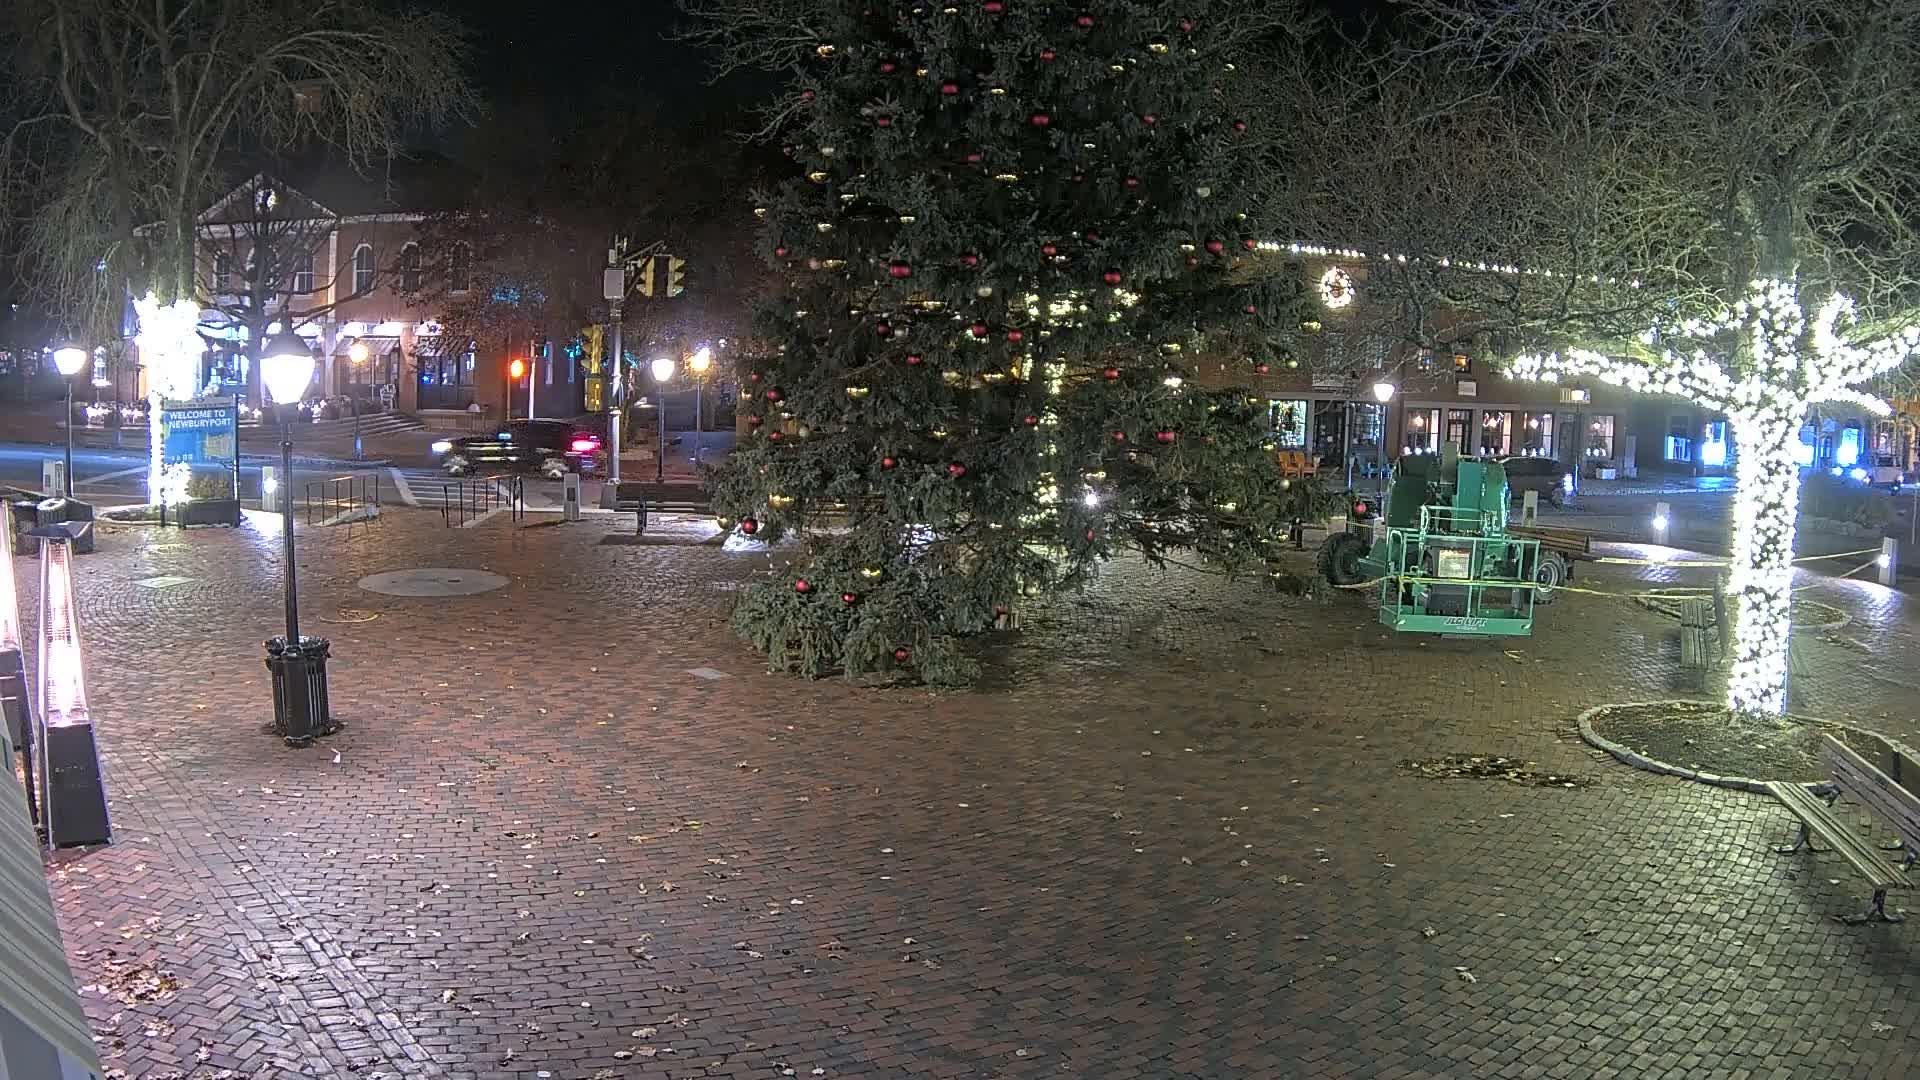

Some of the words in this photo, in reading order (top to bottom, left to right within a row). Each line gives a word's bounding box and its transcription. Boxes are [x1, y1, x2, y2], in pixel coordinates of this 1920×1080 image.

[169, 410, 211, 420] WELCOME
[214, 409, 226, 418] TO
[169, 418, 232, 429] NEWBURYPORT
